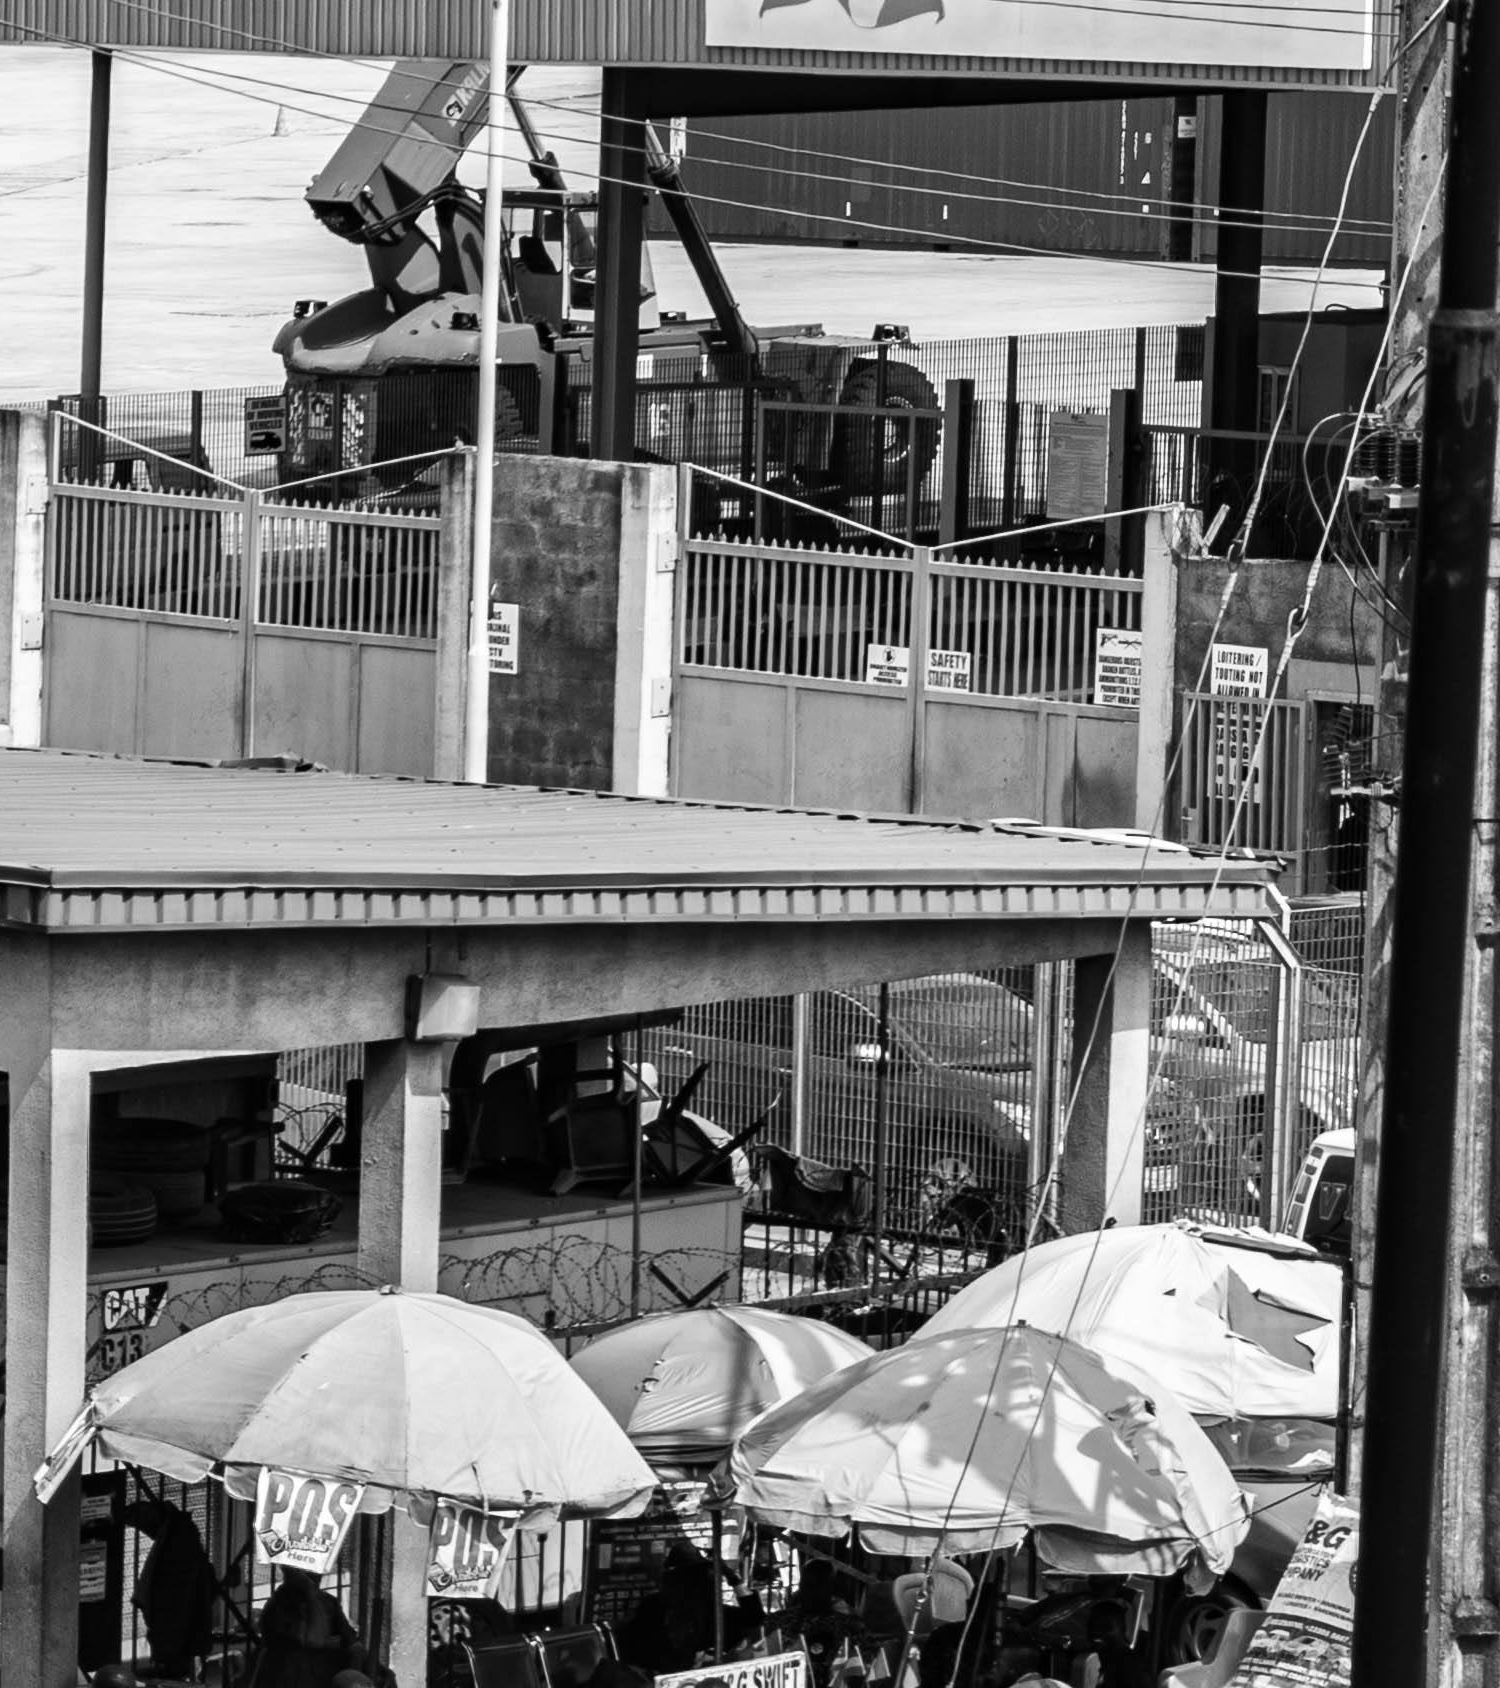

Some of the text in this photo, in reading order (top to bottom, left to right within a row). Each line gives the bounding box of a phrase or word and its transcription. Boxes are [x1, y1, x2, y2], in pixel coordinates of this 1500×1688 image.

[931, 652, 967, 669] SAFETY
[1217, 650, 1254, 666] LOITERING
[929, 670, 950, 687] STARTS
[1215, 667, 1263, 684] TOUTING NOT
[105, 1287, 152, 1330] CAT
[102, 1334, 143, 1370] C13
[266, 1471, 358, 1540] POS
[288, 1551, 315, 1564] Here
